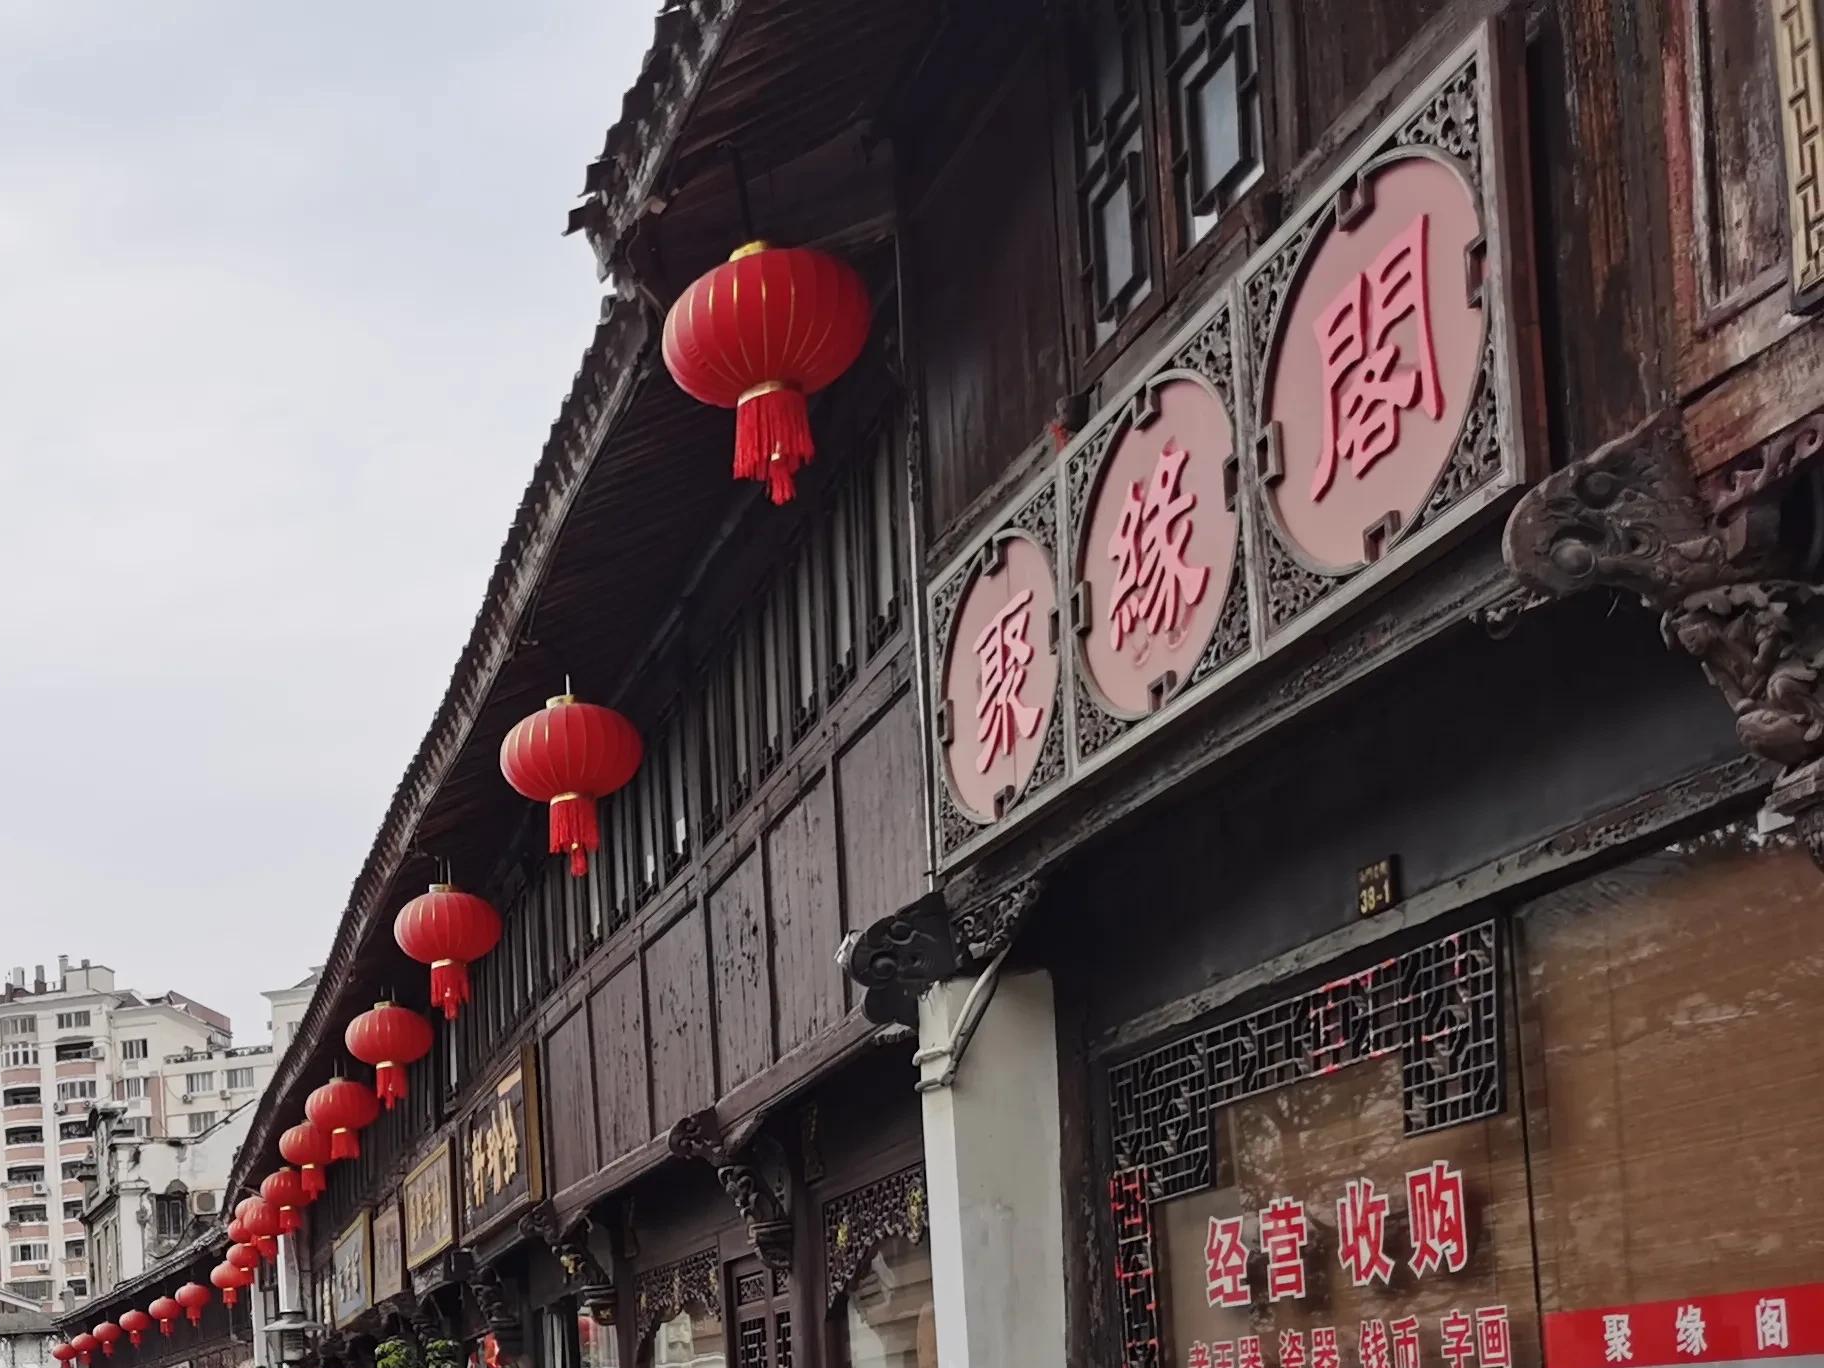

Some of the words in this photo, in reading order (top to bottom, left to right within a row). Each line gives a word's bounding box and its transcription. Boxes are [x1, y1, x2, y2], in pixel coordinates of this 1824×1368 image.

[1359, 878, 1392, 915] 38-1
[1204, 1196, 1308, 1308] 经营
[1337, 1160, 1468, 1287] 收购
[1602, 1297, 1789, 1363] 聚缘阁
